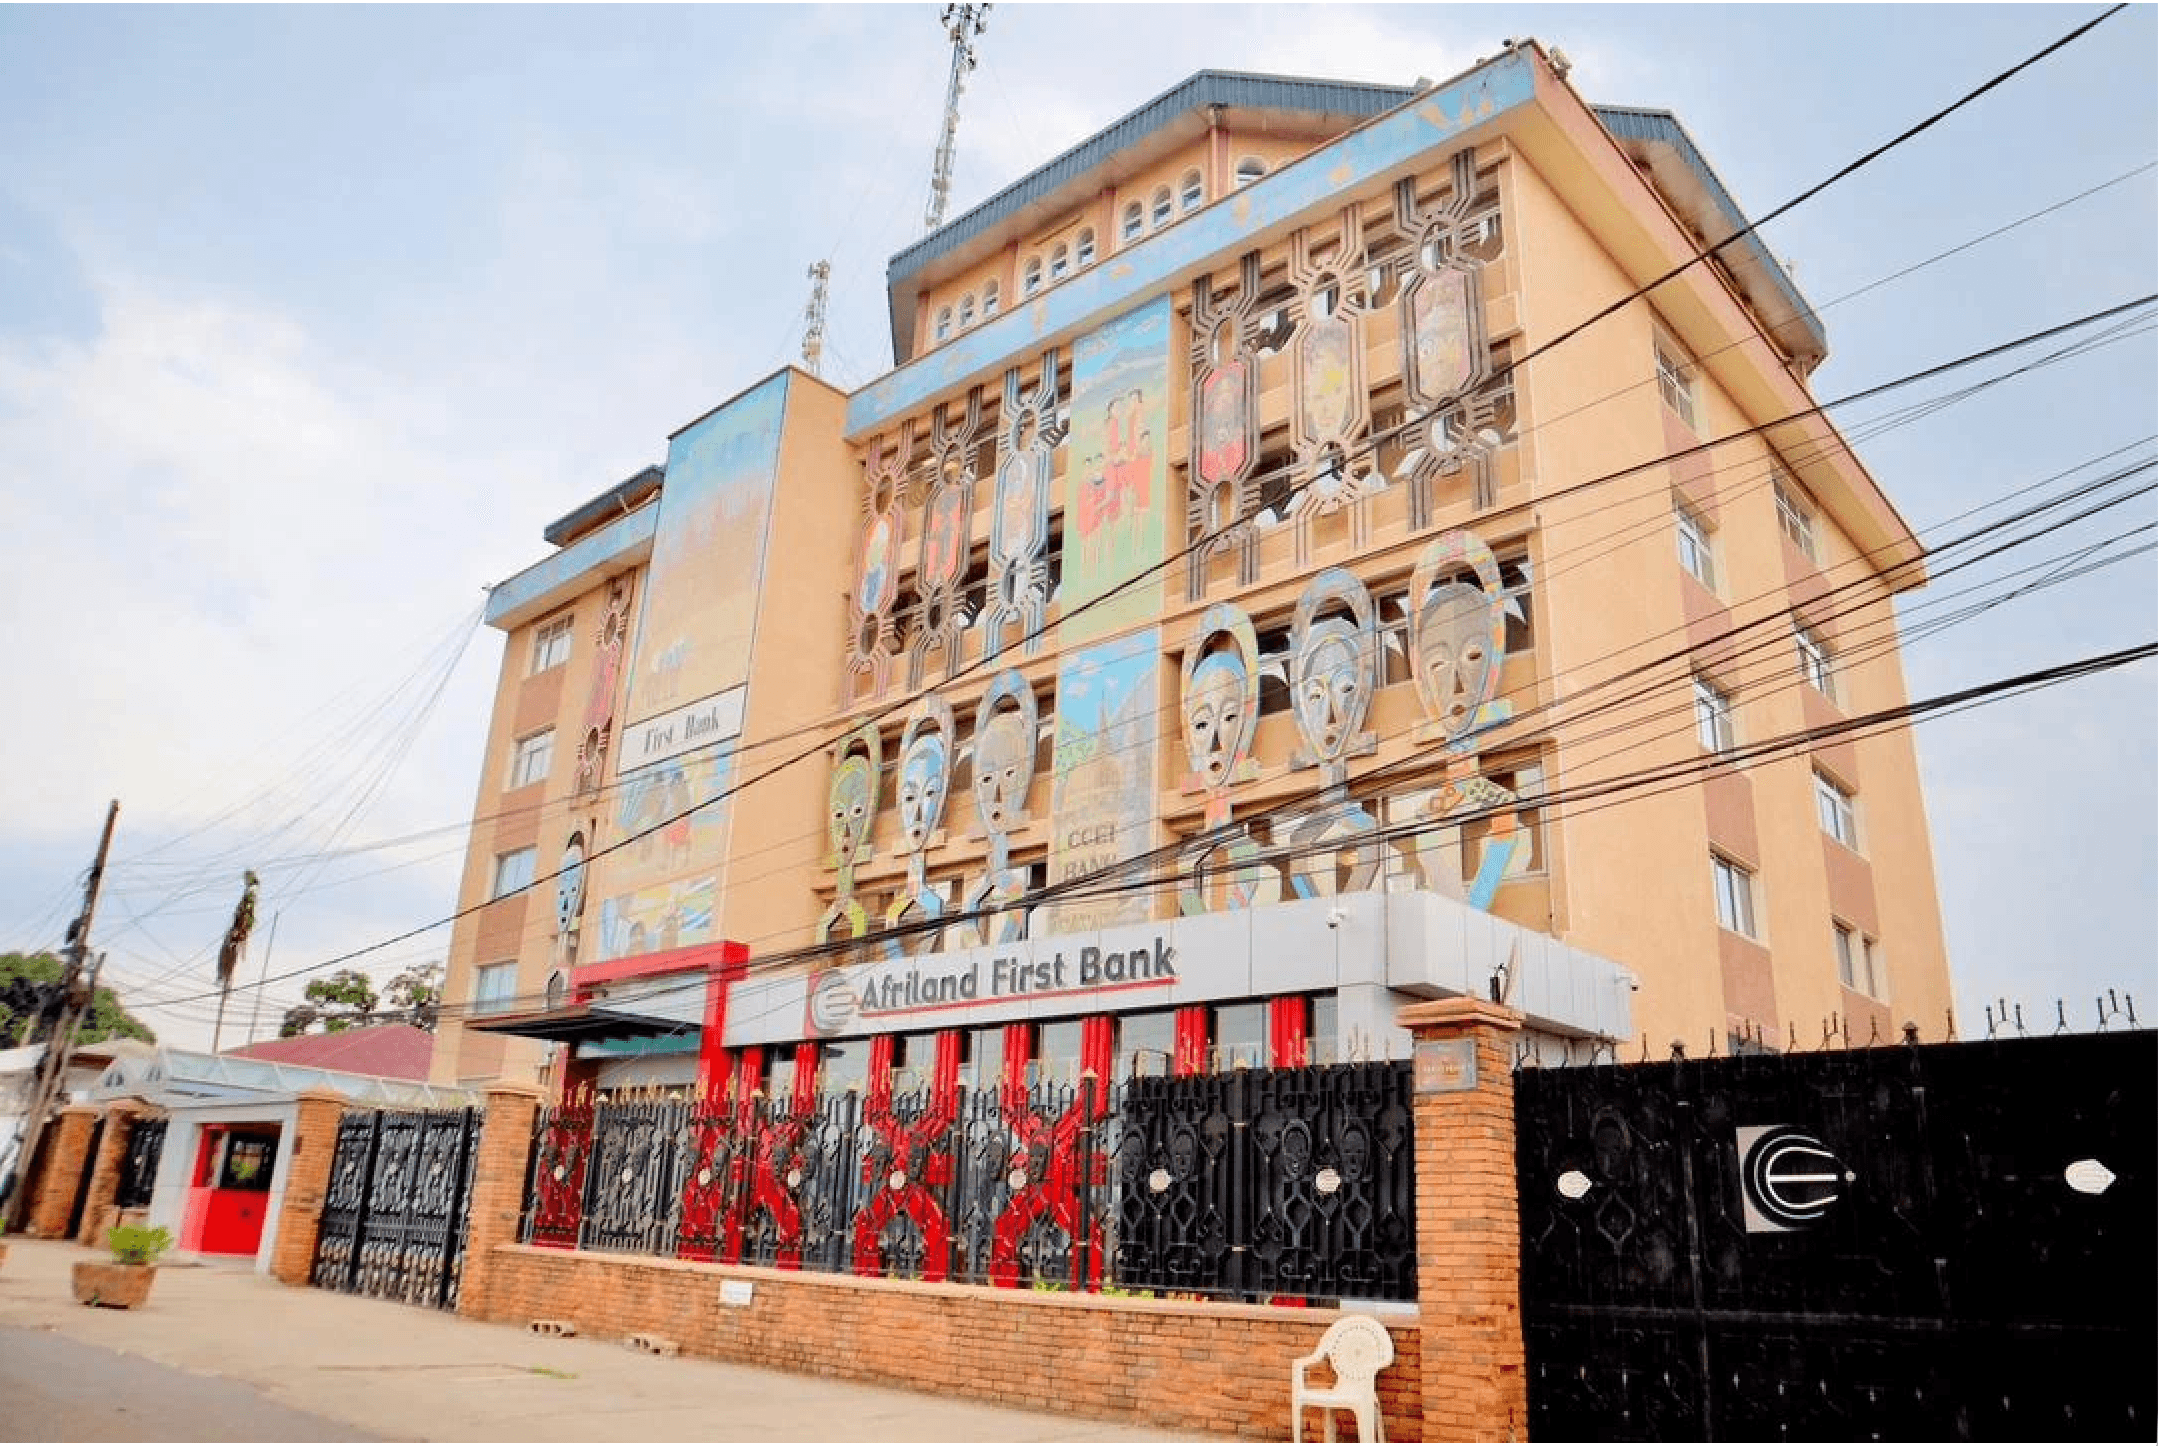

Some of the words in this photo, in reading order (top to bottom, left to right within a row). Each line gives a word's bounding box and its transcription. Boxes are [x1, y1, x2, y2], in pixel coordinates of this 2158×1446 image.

[643, 724, 673, 753] First
[684, 706, 719, 739] Bank
[863, 961, 979, 1008] Afriland
[992, 952, 1064, 995] First
[1080, 936, 1175, 986] Bank
